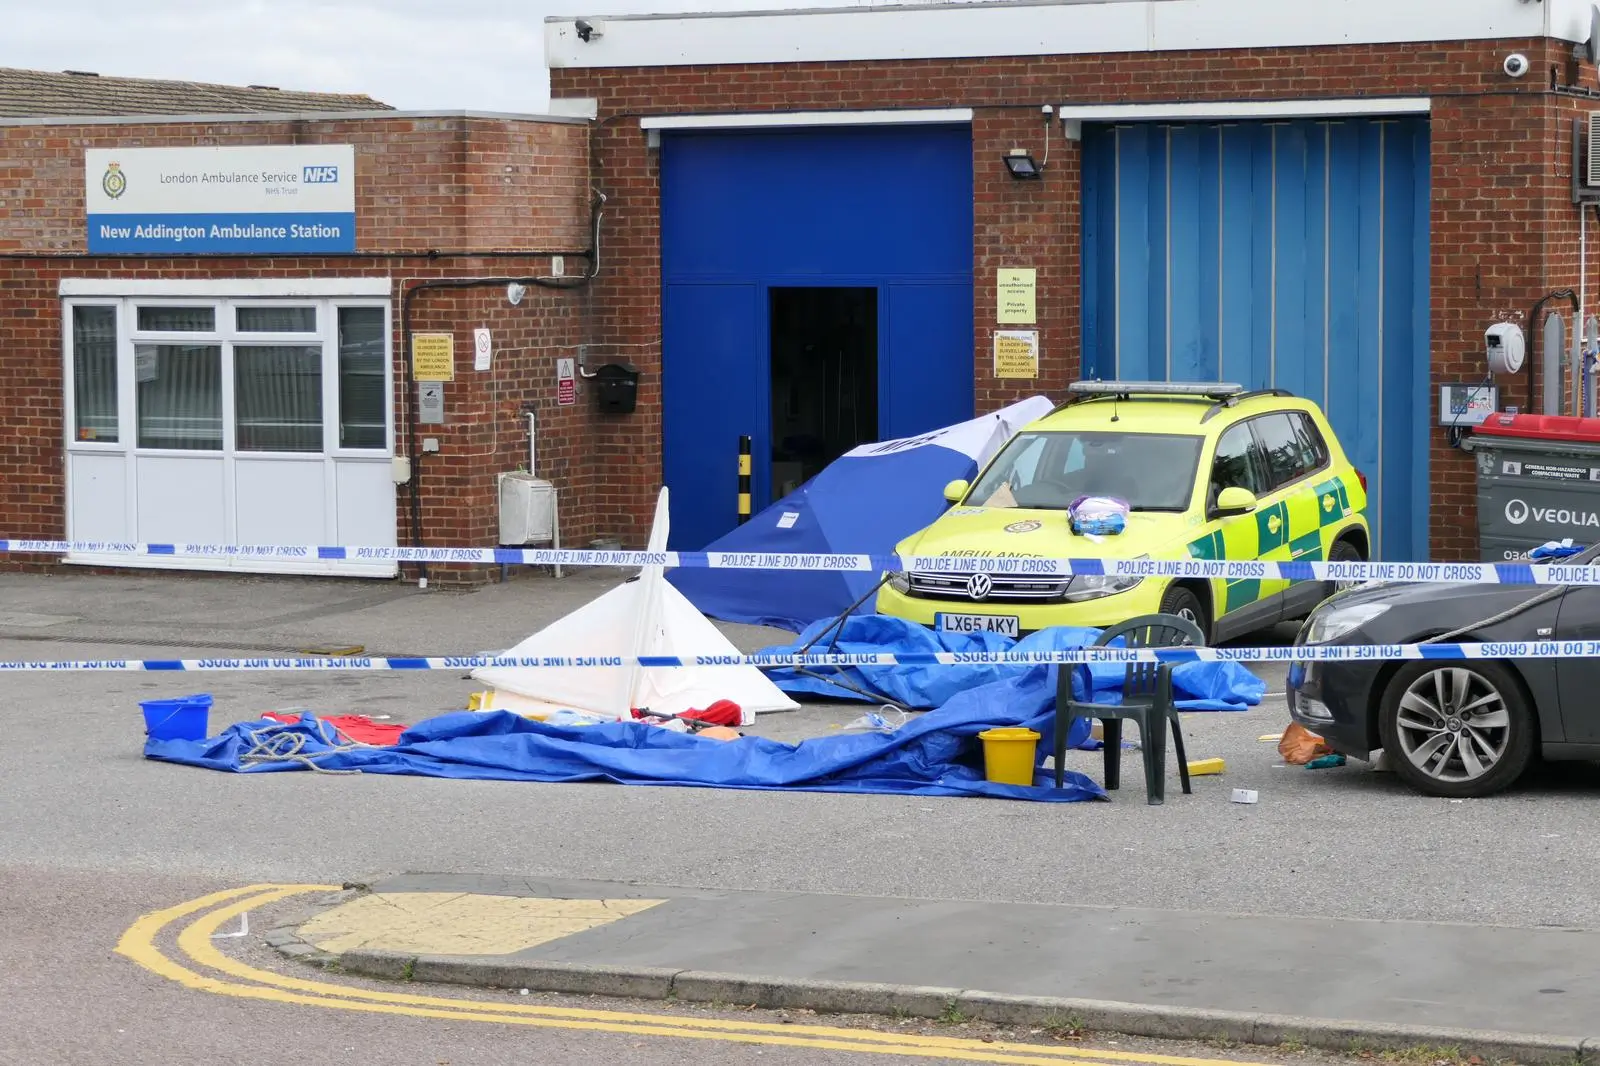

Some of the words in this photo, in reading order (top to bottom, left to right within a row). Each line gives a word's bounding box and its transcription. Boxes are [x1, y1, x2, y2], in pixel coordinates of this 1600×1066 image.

[160, 172, 198, 184] London
[201, 171, 259, 183] Ambulance
[262, 171, 297, 183] Service
[304, 167, 337, 183] NHS
[281, 187, 298, 195] Trust
[100, 225, 131, 239] New
[134, 224, 206, 242] Addington
[210, 224, 286, 239] Ambulance
[290, 224, 340, 239] Station
[1525, 463, 1546, 471] GENERAL
[1545, 465, 1586, 474] NON-HAZARDOUS
[1532, 507, 1600, 527] VEOLIA
[185, 543, 217, 553] POLICE
[218, 544, 239, 554] LINE
[240, 545, 255, 555] DO
[256, 545, 274, 555] NOT
[277, 546, 307, 556] CROSS
[357, 547, 390, 557] POLICE
[390, 548, 415, 559] LINE
[415, 548, 429, 559] DO
[429, 549, 448, 560] NOT
[449, 549, 483, 560] CROSS
[1503, 550, 1530, 561] 034
[534, 551, 570, 562] POLICE
[570, 551, 593, 563] LINE
[594, 552, 610, 563] DO
[611, 552, 631, 564] NOT
[633, 553, 667, 565] CROSS
[720, 554, 756, 566] POLICE
[757, 555, 781, 567] LINE
[782, 555, 798, 567] DO
[800, 556, 821, 568] NOT
[823, 556, 858, 568] CROSS
[914, 558, 951, 571] POLICE
[953, 558, 977, 571] LINE
[979, 559, 995, 571] DO
[997, 559, 1020, 572] NOT
[1021, 560, 1057, 573] CROSS
[1117, 561, 1155, 574] POLICE
[1157, 562, 1182, 575] LINE
[1184, 562, 1200, 575] DO
[1202, 562, 1225, 575] NOT
[1228, 563, 1265, 576] CROSS
[1327, 564, 1366, 578] POLICE
[1369, 565, 1395, 578] LINE
[1398, 565, 1414, 579] DO
[1417, 566, 1440, 579] NOT
[1443, 566, 1482, 580] CROSS
[1548, 567, 1589, 582] POLICE
[945, 615, 982, 631] LX65
[987, 617, 1014, 633] AKY
[1091, 649, 1138, 661] POLICE
[1215, 648, 1260, 659] CROSS
[1265, 647, 1292, 659] NOT
[1297, 646, 1316, 659] DO
[1320, 645, 1350, 658] LINE
[1355, 645, 1402, 657] POLICE
[1481, 643, 1527, 656] CROSS
[1531, 643, 1559, 655] NOT
[1564, 642, 1583, 655] DO
[953, 652, 998, 662] CROSS
[1002, 651, 1029, 662] NOT
[1034, 651, 1052, 661] DO
[1057, 650, 1087, 661] LINE
